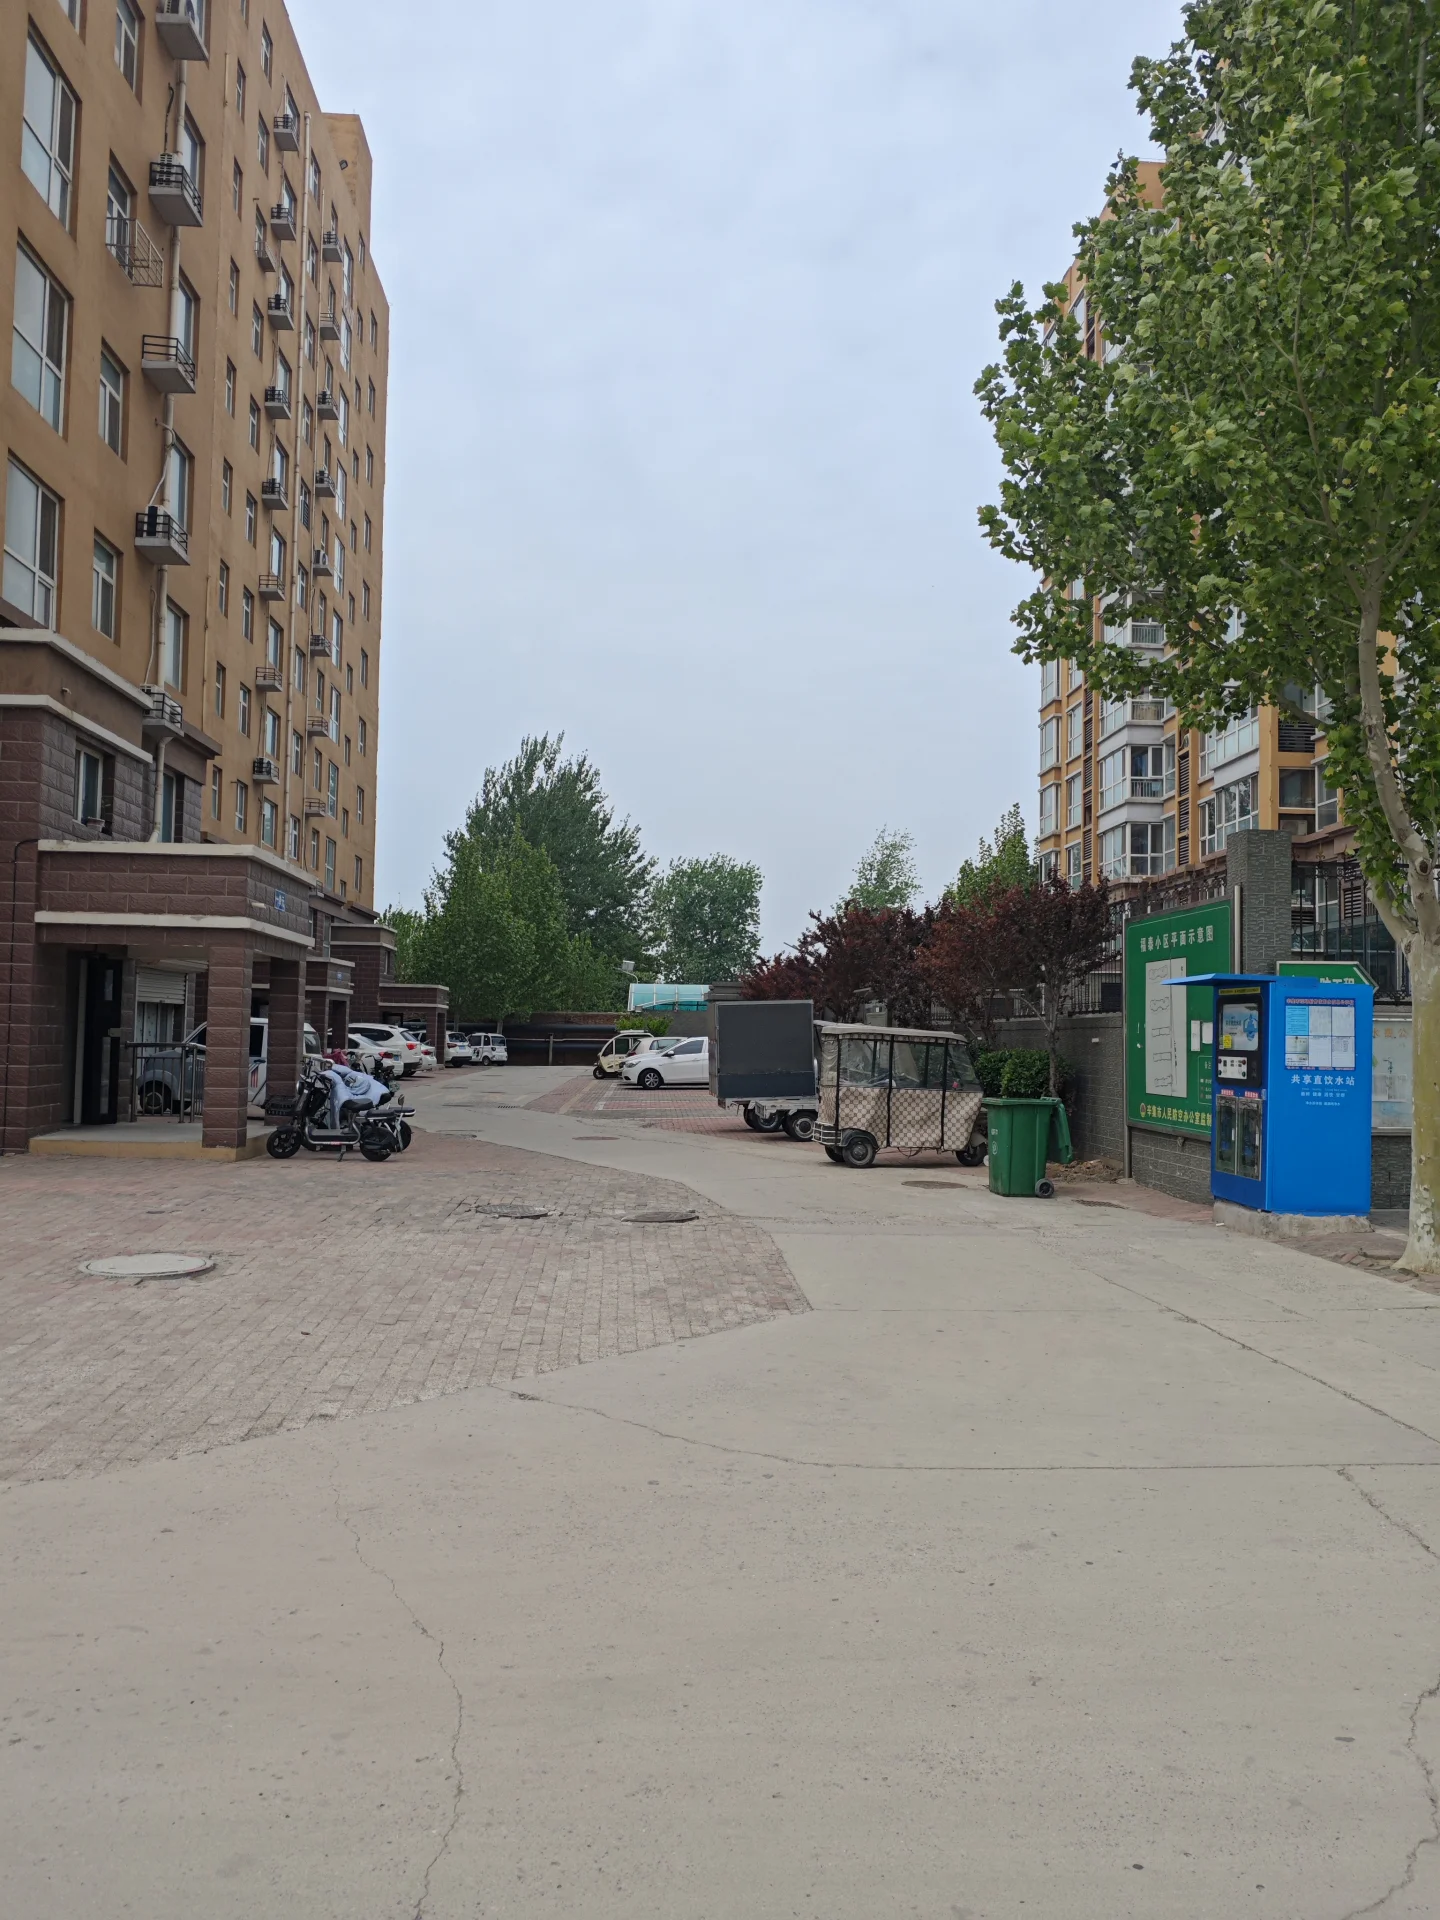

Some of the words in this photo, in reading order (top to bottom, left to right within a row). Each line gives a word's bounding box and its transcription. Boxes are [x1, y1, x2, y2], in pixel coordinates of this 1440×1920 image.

[1140, 925, 1214, 953] 福泰小区平面示意图
[1290, 1074, 1355, 1086] 共享直饮水站
[1146, 1104, 1212, 1127] 辛集市人民防空办公室监制
